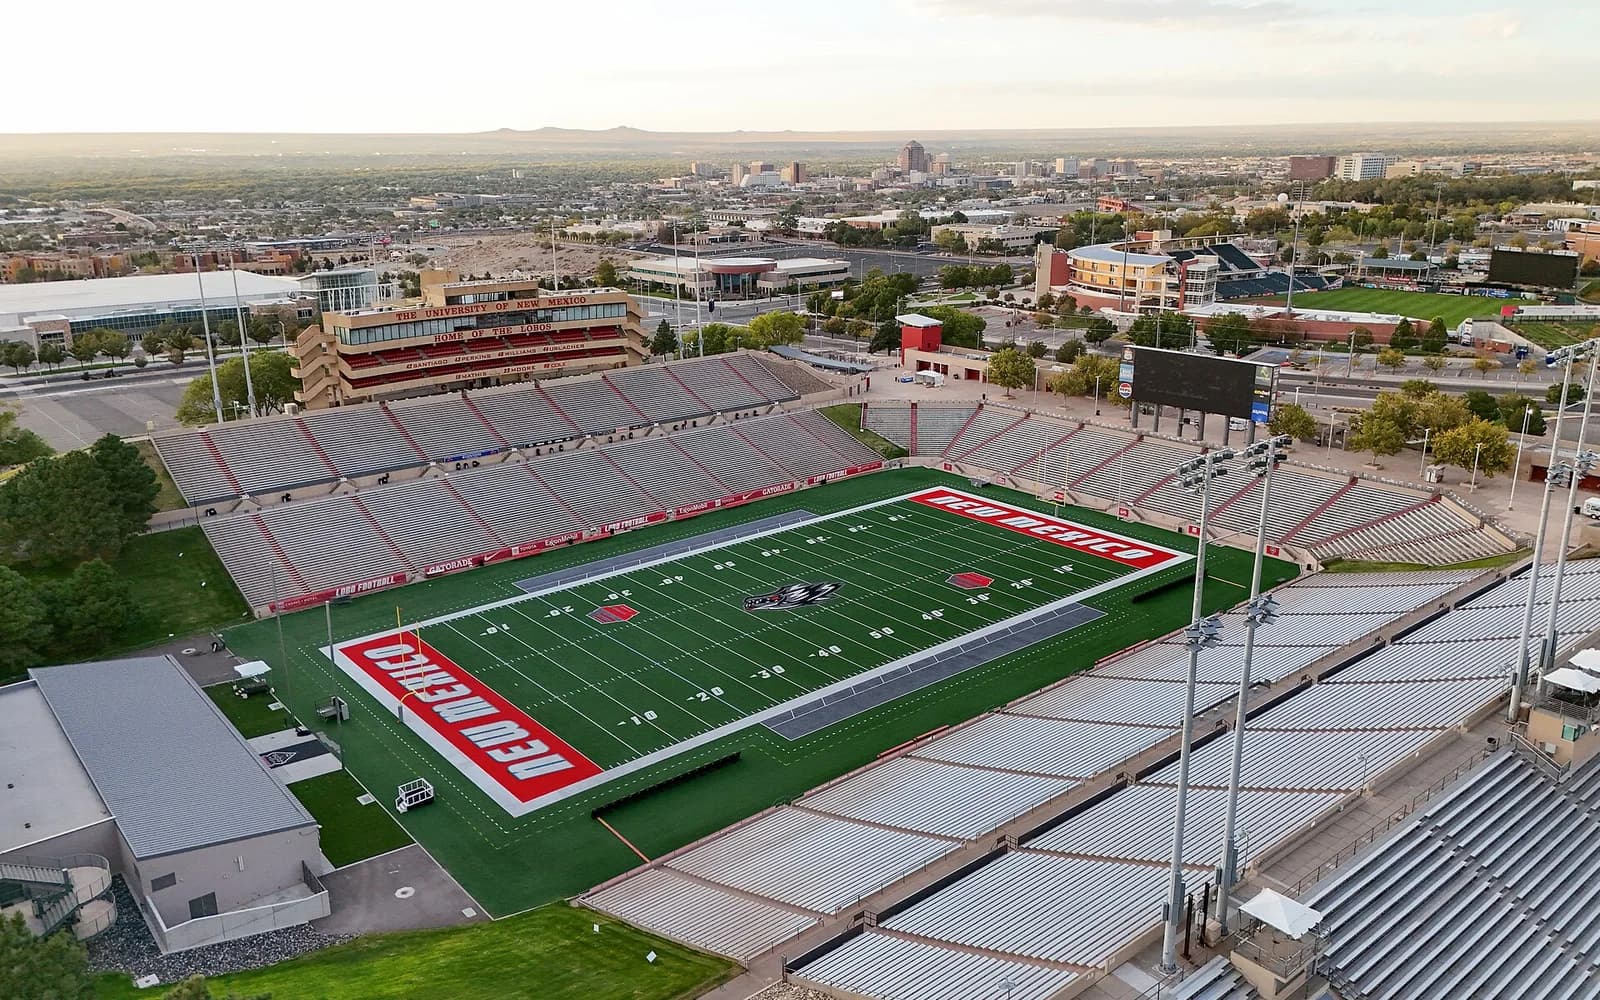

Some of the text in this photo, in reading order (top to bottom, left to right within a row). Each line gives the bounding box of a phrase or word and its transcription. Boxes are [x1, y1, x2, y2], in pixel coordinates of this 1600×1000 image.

[396, 312, 417, 320] THE
[425, 305, 487, 317] UNIVERSITY
[517, 300, 539, 309] NEW
[548, 296, 586, 306] MEXICO
[434, 332, 463, 343] HOME
[492, 327, 512, 335] THE
[520, 323, 552, 332] LOBOS
[762, 483, 792, 495] GATORADE
[926, 495, 1154, 560] NEW MEXICO
[544, 533, 578, 547] ExxonMobil
[427, 558, 473, 574] GATORADE
[336, 576, 396, 598] LOBO FOOTBALL
[921, 609, 943, 621] 40
[869, 627, 894, 639] 50
[818, 645, 842, 657] 40
[757, 665, 786, 679] 30
[696, 687, 725, 702] 20
[363, 643, 576, 780] NEW MEXICO
[630, 710, 658, 726] 10
